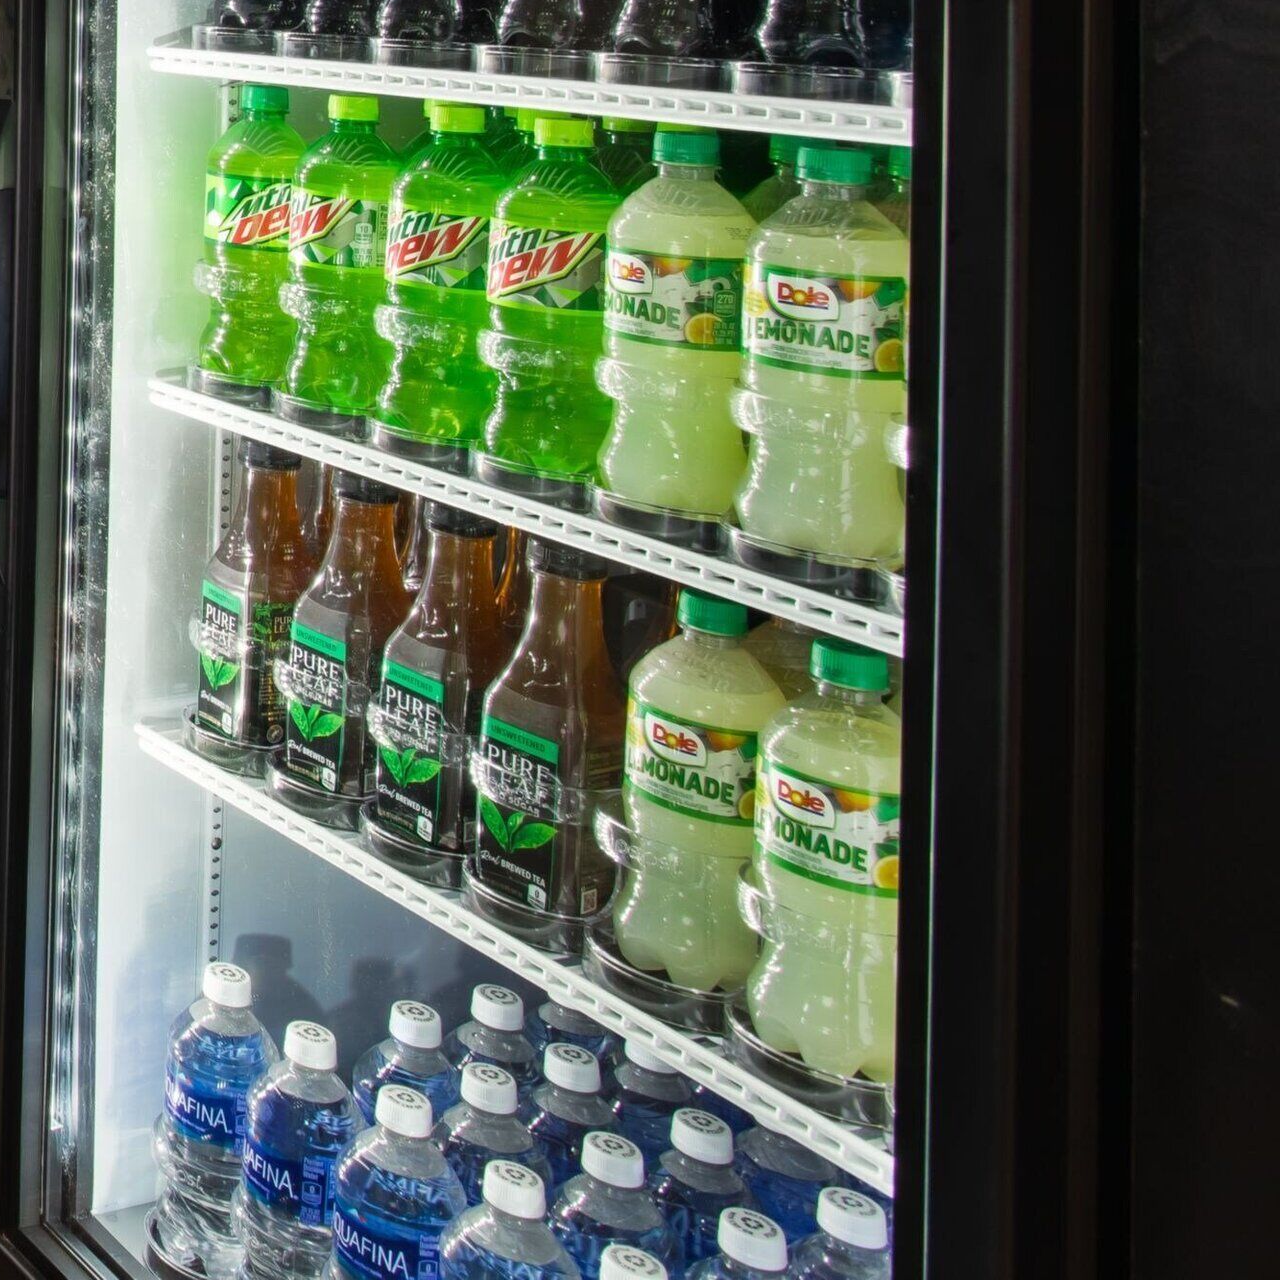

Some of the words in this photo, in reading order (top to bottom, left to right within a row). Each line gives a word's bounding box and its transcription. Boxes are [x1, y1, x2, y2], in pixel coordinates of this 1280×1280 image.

[612, 259, 645, 281] Dole
[716, 294, 733, 304] 270
[777, 281, 830, 306] Dole
[748, 316, 871, 357] LEMONADE
[206, 603, 237, 633] PURE
[296, 627, 338, 652] UNSWEETENED
[293, 645, 340, 681] PURE
[292, 668, 340, 700] LEAF
[385, 684, 437, 725] PURE
[385, 703, 438, 744] LEAF
[491, 723, 546, 752] UNSWEETENED
[652, 722, 699, 753] Dole
[325, 757, 336, 769] TEA
[488, 743, 551, 785] PURE
[378, 783, 396, 800] Real
[395, 792, 427, 813] BREWED
[777, 778, 826, 813] Dole
[480, 849, 500, 867] Real
[500, 859, 531, 882] BREWED
[532, 872, 546, 888] TEA
[333, 1210, 410, 1280] QUAFINA
